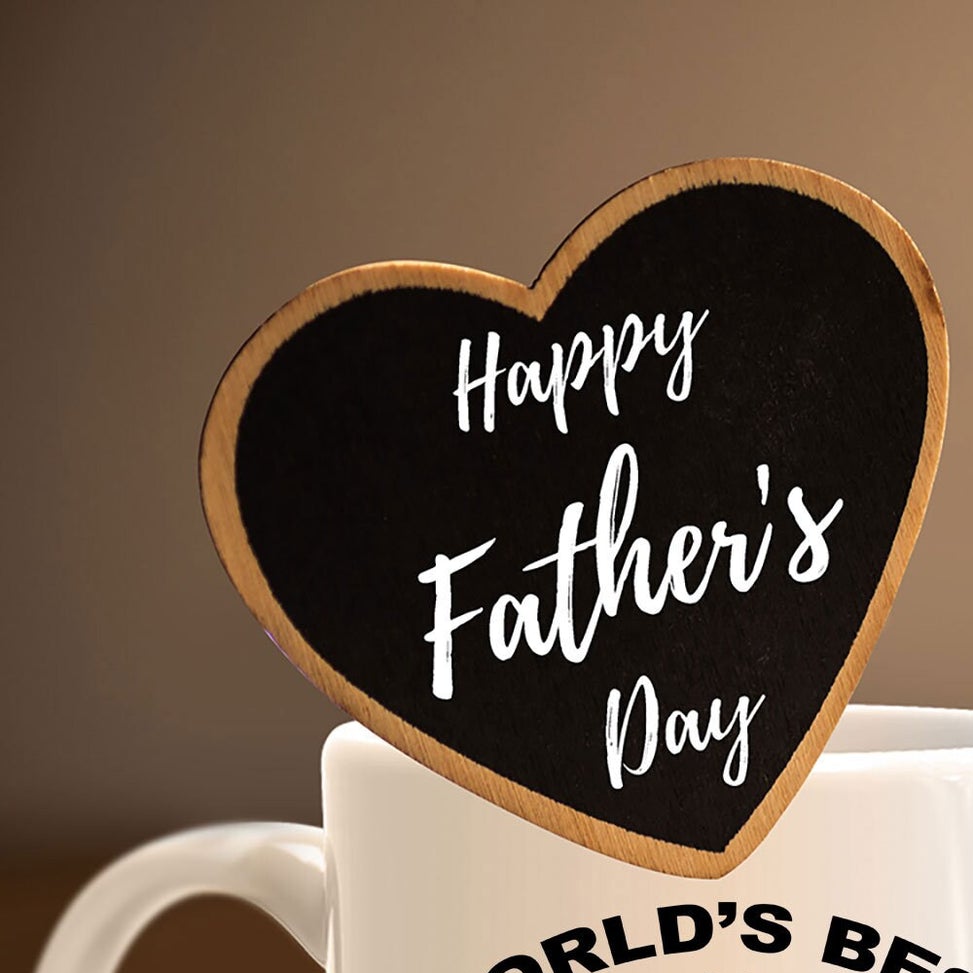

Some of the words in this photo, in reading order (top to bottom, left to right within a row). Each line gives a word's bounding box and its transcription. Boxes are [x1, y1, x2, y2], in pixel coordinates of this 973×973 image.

[452, 307, 710, 434] Happy
[417, 443, 844, 700] Father's
[605, 675, 766, 790] Day
